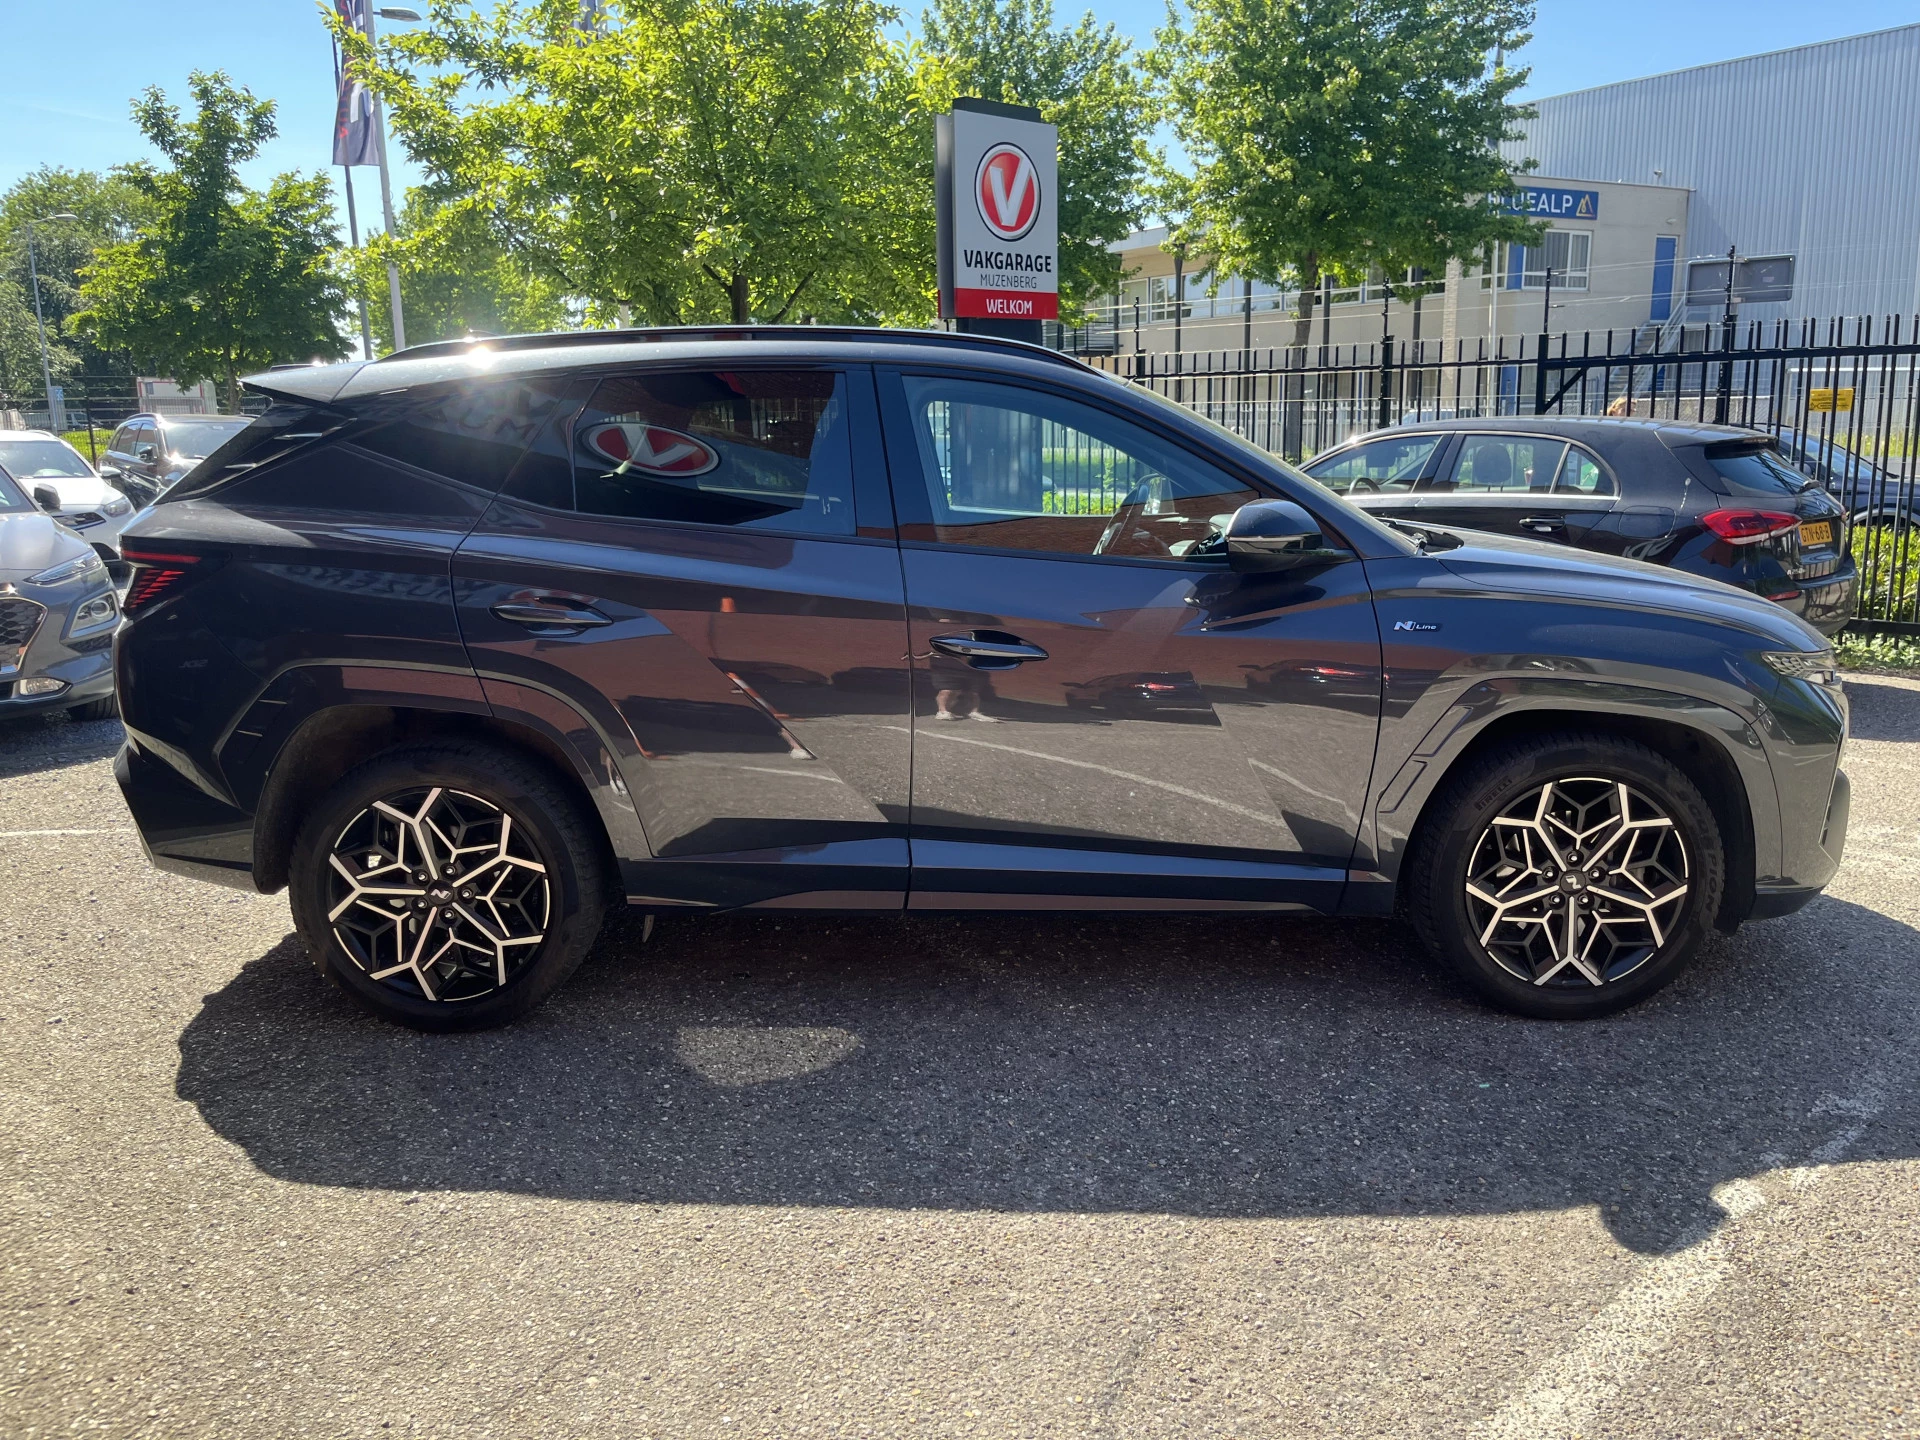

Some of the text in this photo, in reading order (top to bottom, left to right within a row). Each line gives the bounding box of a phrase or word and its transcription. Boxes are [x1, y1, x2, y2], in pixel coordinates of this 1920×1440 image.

[963, 249, 1052, 273] VAKGARAGE
[980, 273, 1037, 289] MUZENBERG
[986, 298, 1033, 315] WELKOM
